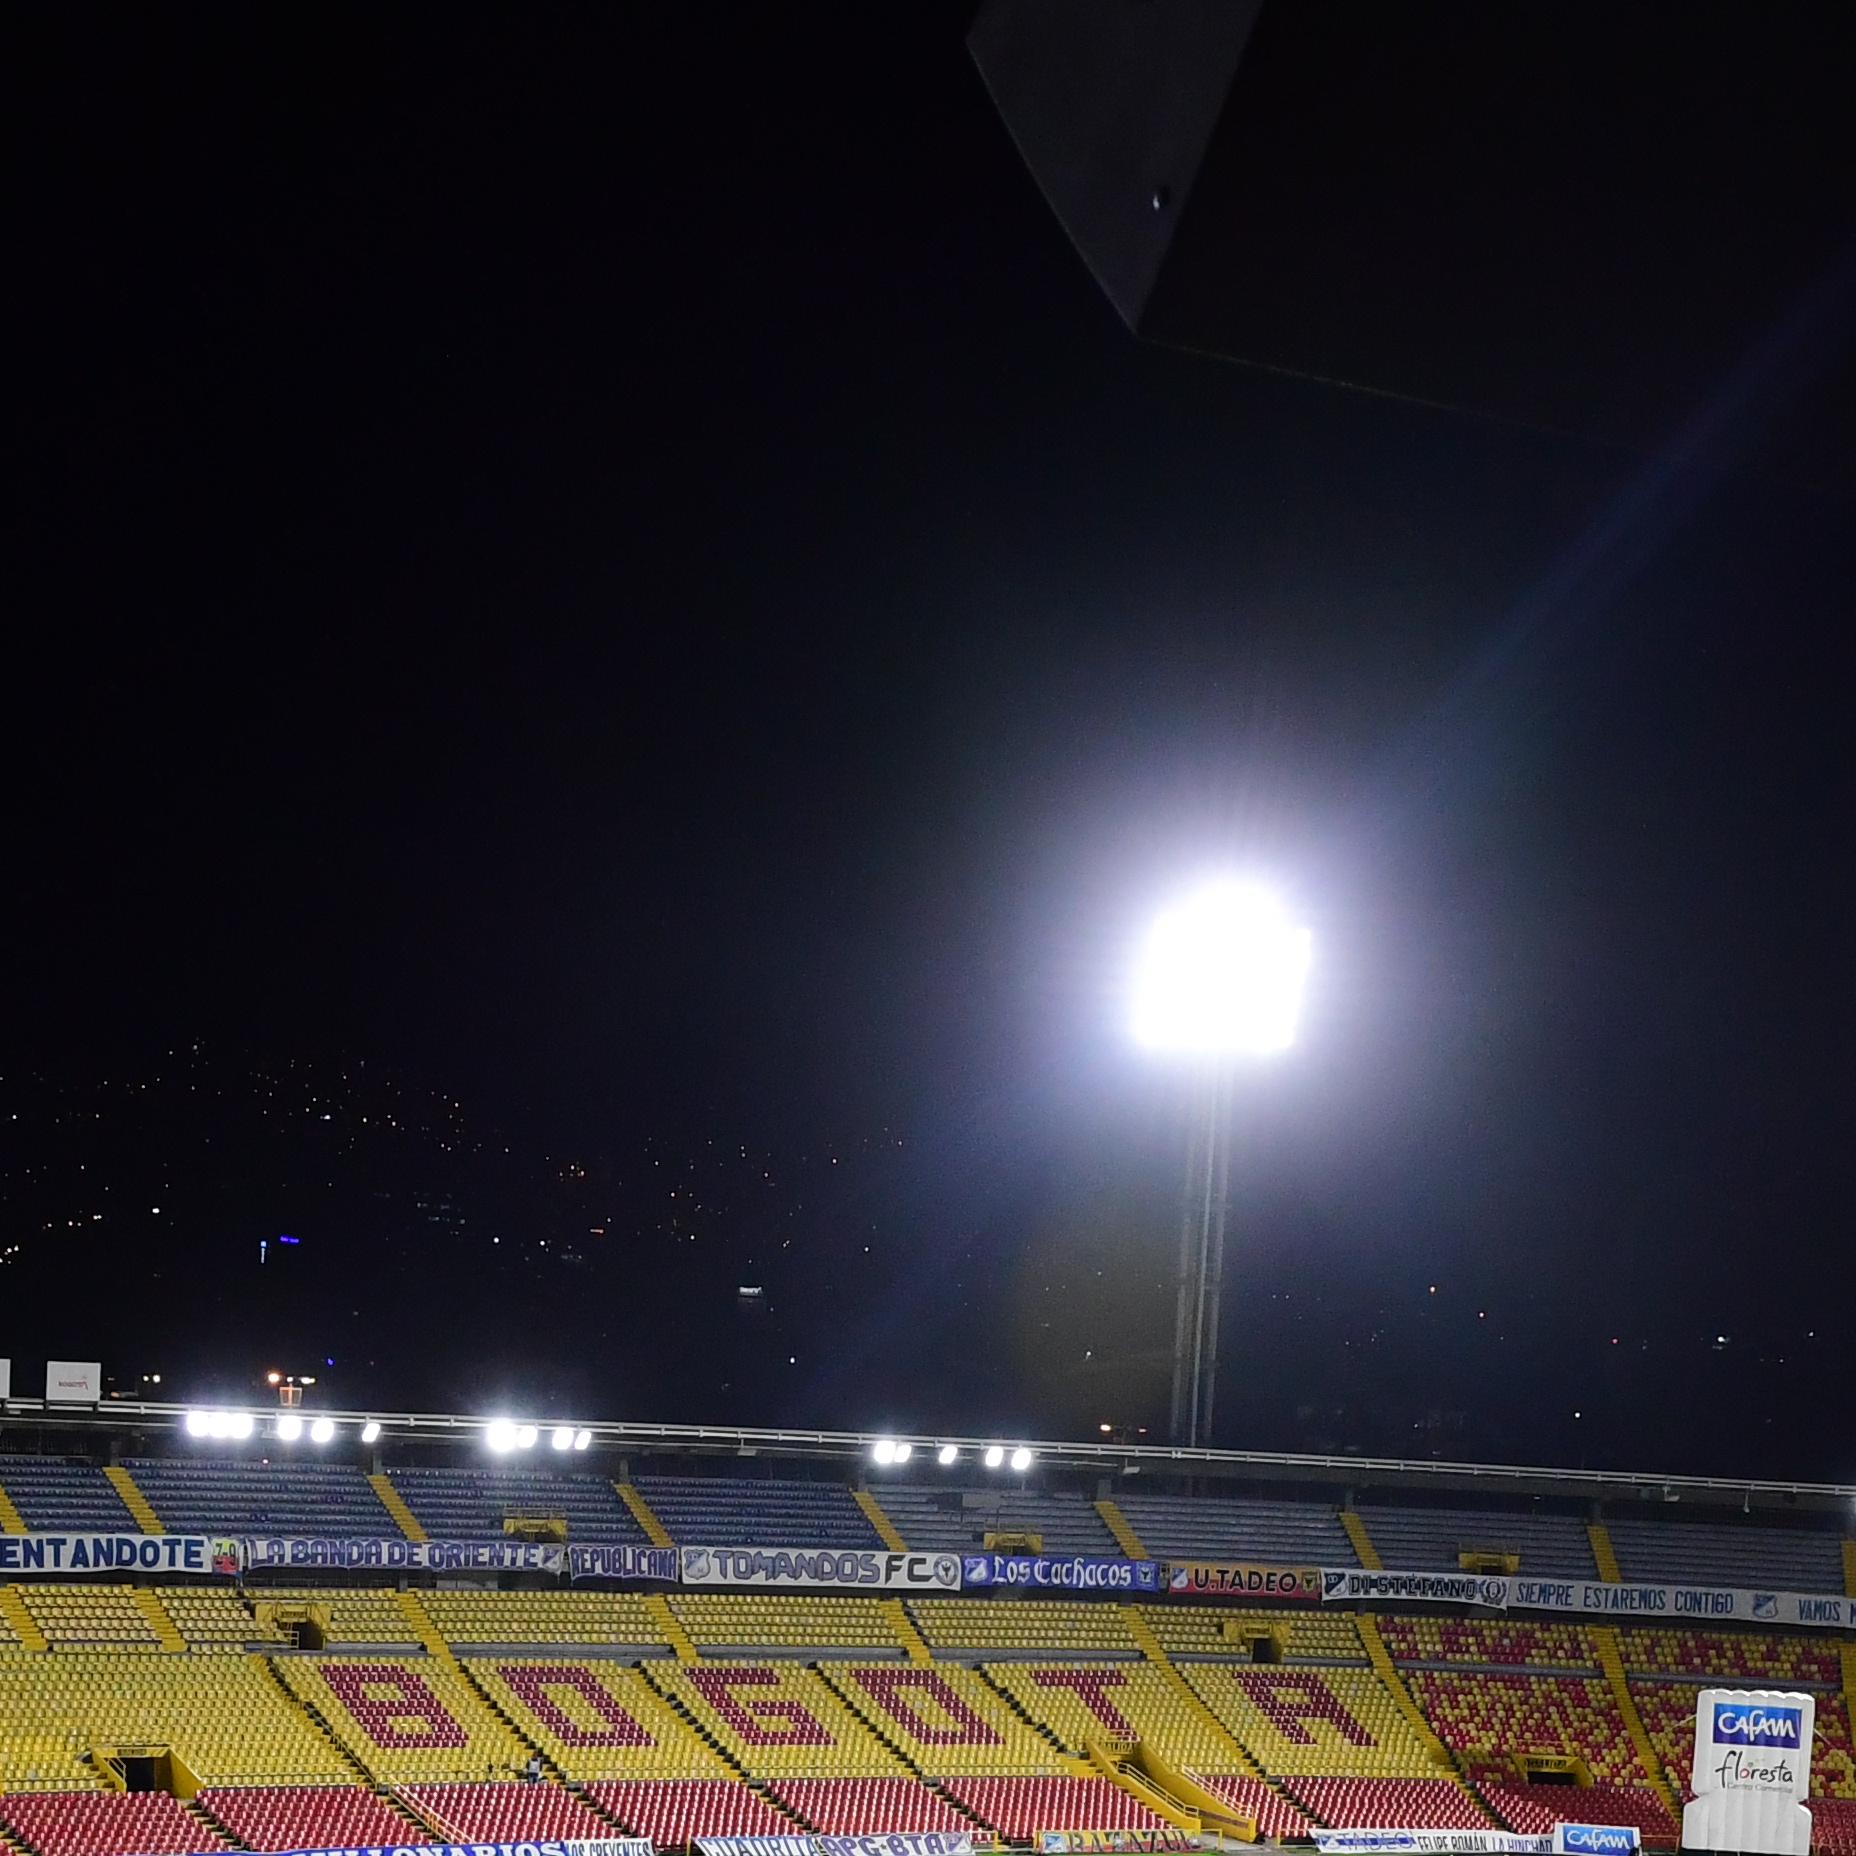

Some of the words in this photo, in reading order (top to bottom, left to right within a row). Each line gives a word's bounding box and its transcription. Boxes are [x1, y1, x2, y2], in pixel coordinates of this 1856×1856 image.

[251, 1538, 286, 1566] LA
[291, 1539, 383, 1567] BANDA
[388, 1541, 423, 1567] DE
[428, 1541, 540, 1569] ORIENTE
[571, 1547, 677, 1578] REPUBLICANA
[712, 1550, 881, 1583] TOMANDOS
[884, 1555, 937, 1587] FC
[1194, 1567, 1297, 1593] U.TADEO
[1348, 1574, 1372, 1596] DI
[1516, 1582, 1575, 1606] SIEMPRE
[1584, 1586, 1666, 1612] ESTAREMOS
[1675, 1590, 1734, 1615] CONTIGO
[1797, 1599, 1841, 1622] VAMOS
[1714, 1749, 1794, 1789] floresta
[1417, 1835, 1449, 1851] FELIPE
